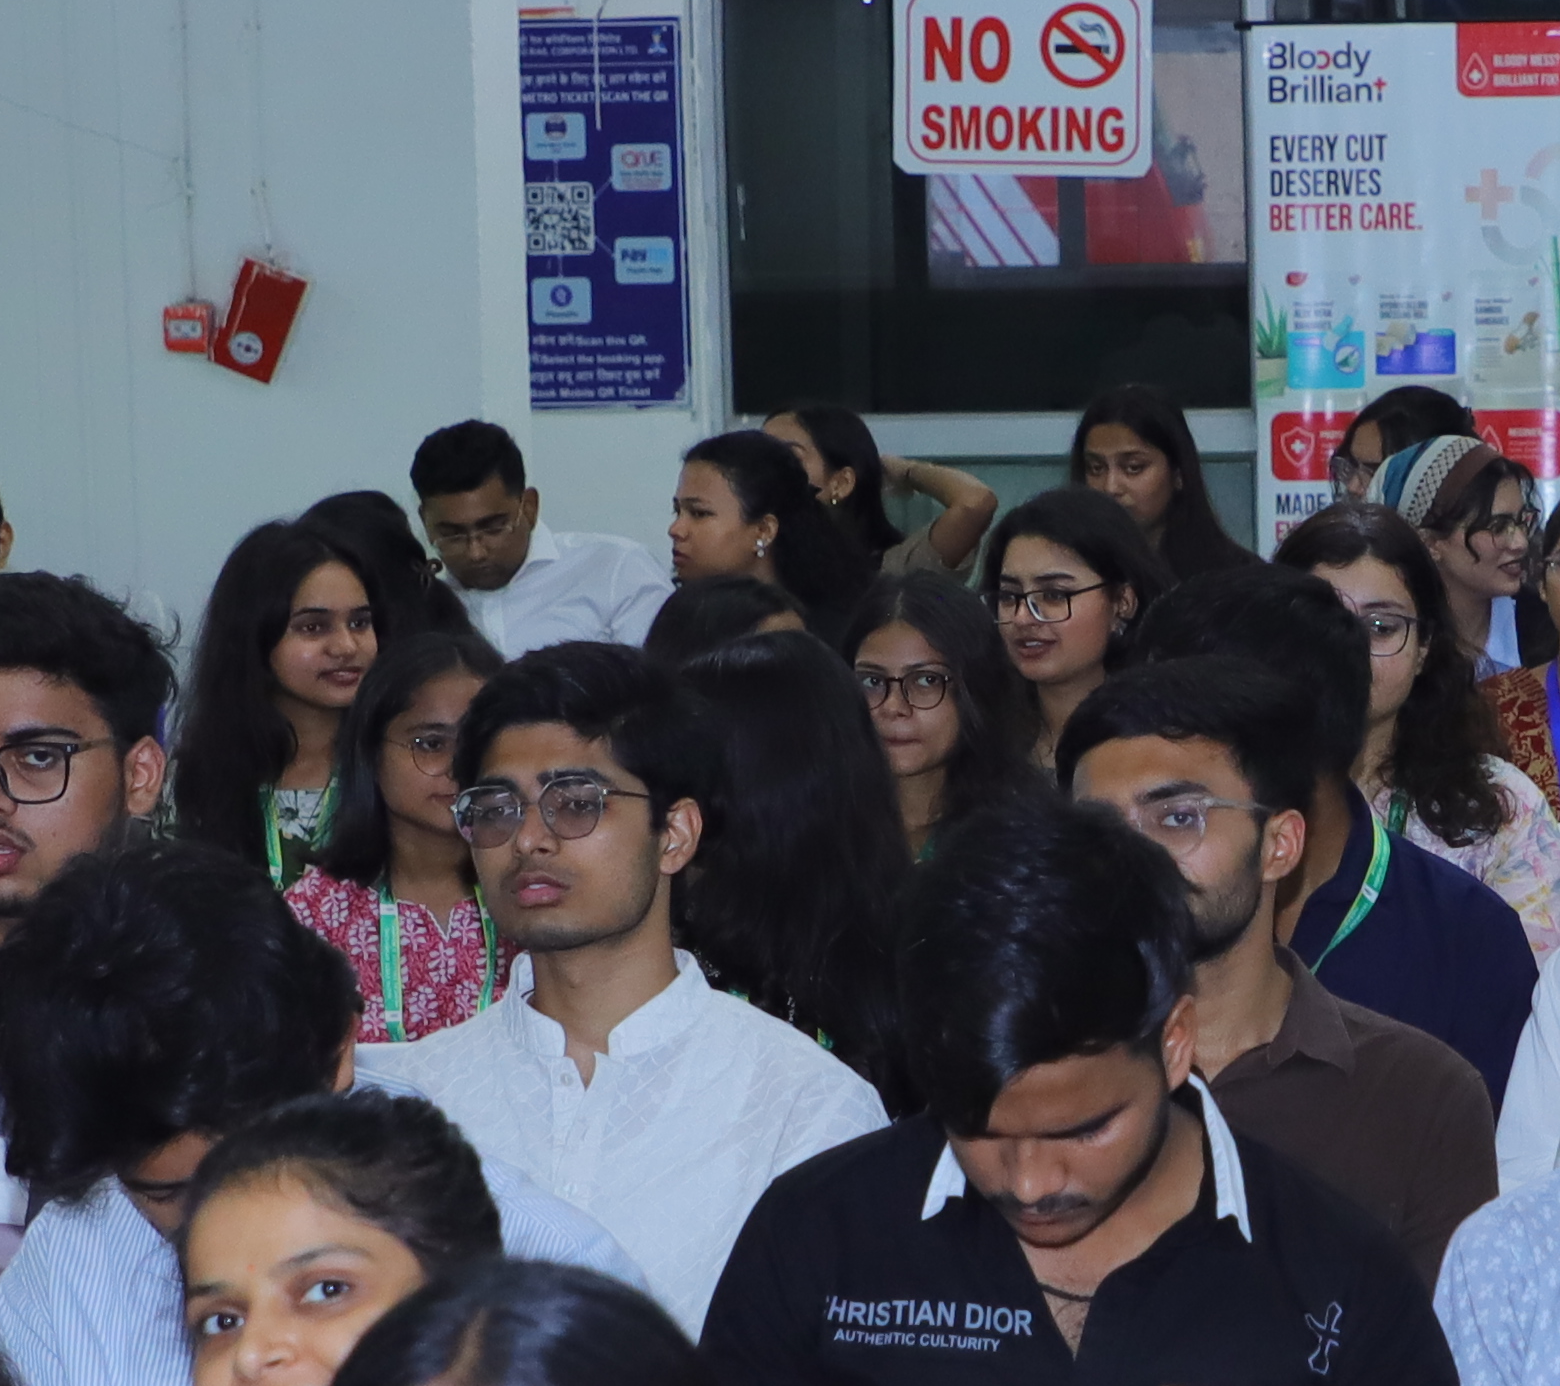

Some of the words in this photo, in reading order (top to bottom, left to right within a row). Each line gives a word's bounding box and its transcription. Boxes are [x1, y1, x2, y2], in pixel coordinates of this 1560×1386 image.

[924, 16, 1011, 83] NO
[1268, 41, 1371, 77] Bloody
[1492, 54, 1527, 68] BLOODY
[1268, 75, 1388, 104] Brilliant
[1493, 73, 1538, 87] BRILLIANT
[921, 104, 1125, 153] SMOKING
[1270, 134, 1338, 163] EVERY
[1346, 134, 1388, 162] CUT
[1270, 168, 1382, 197] DESERVES
[1269, 203, 1353, 232] BETTER
[1359, 202, 1423, 231] CARE.
[964, 1304, 1033, 1336] DIOR
[833, 1328, 916, 1349] AUTHENTIC
[919, 1332, 1000, 1353] CULTURITY
